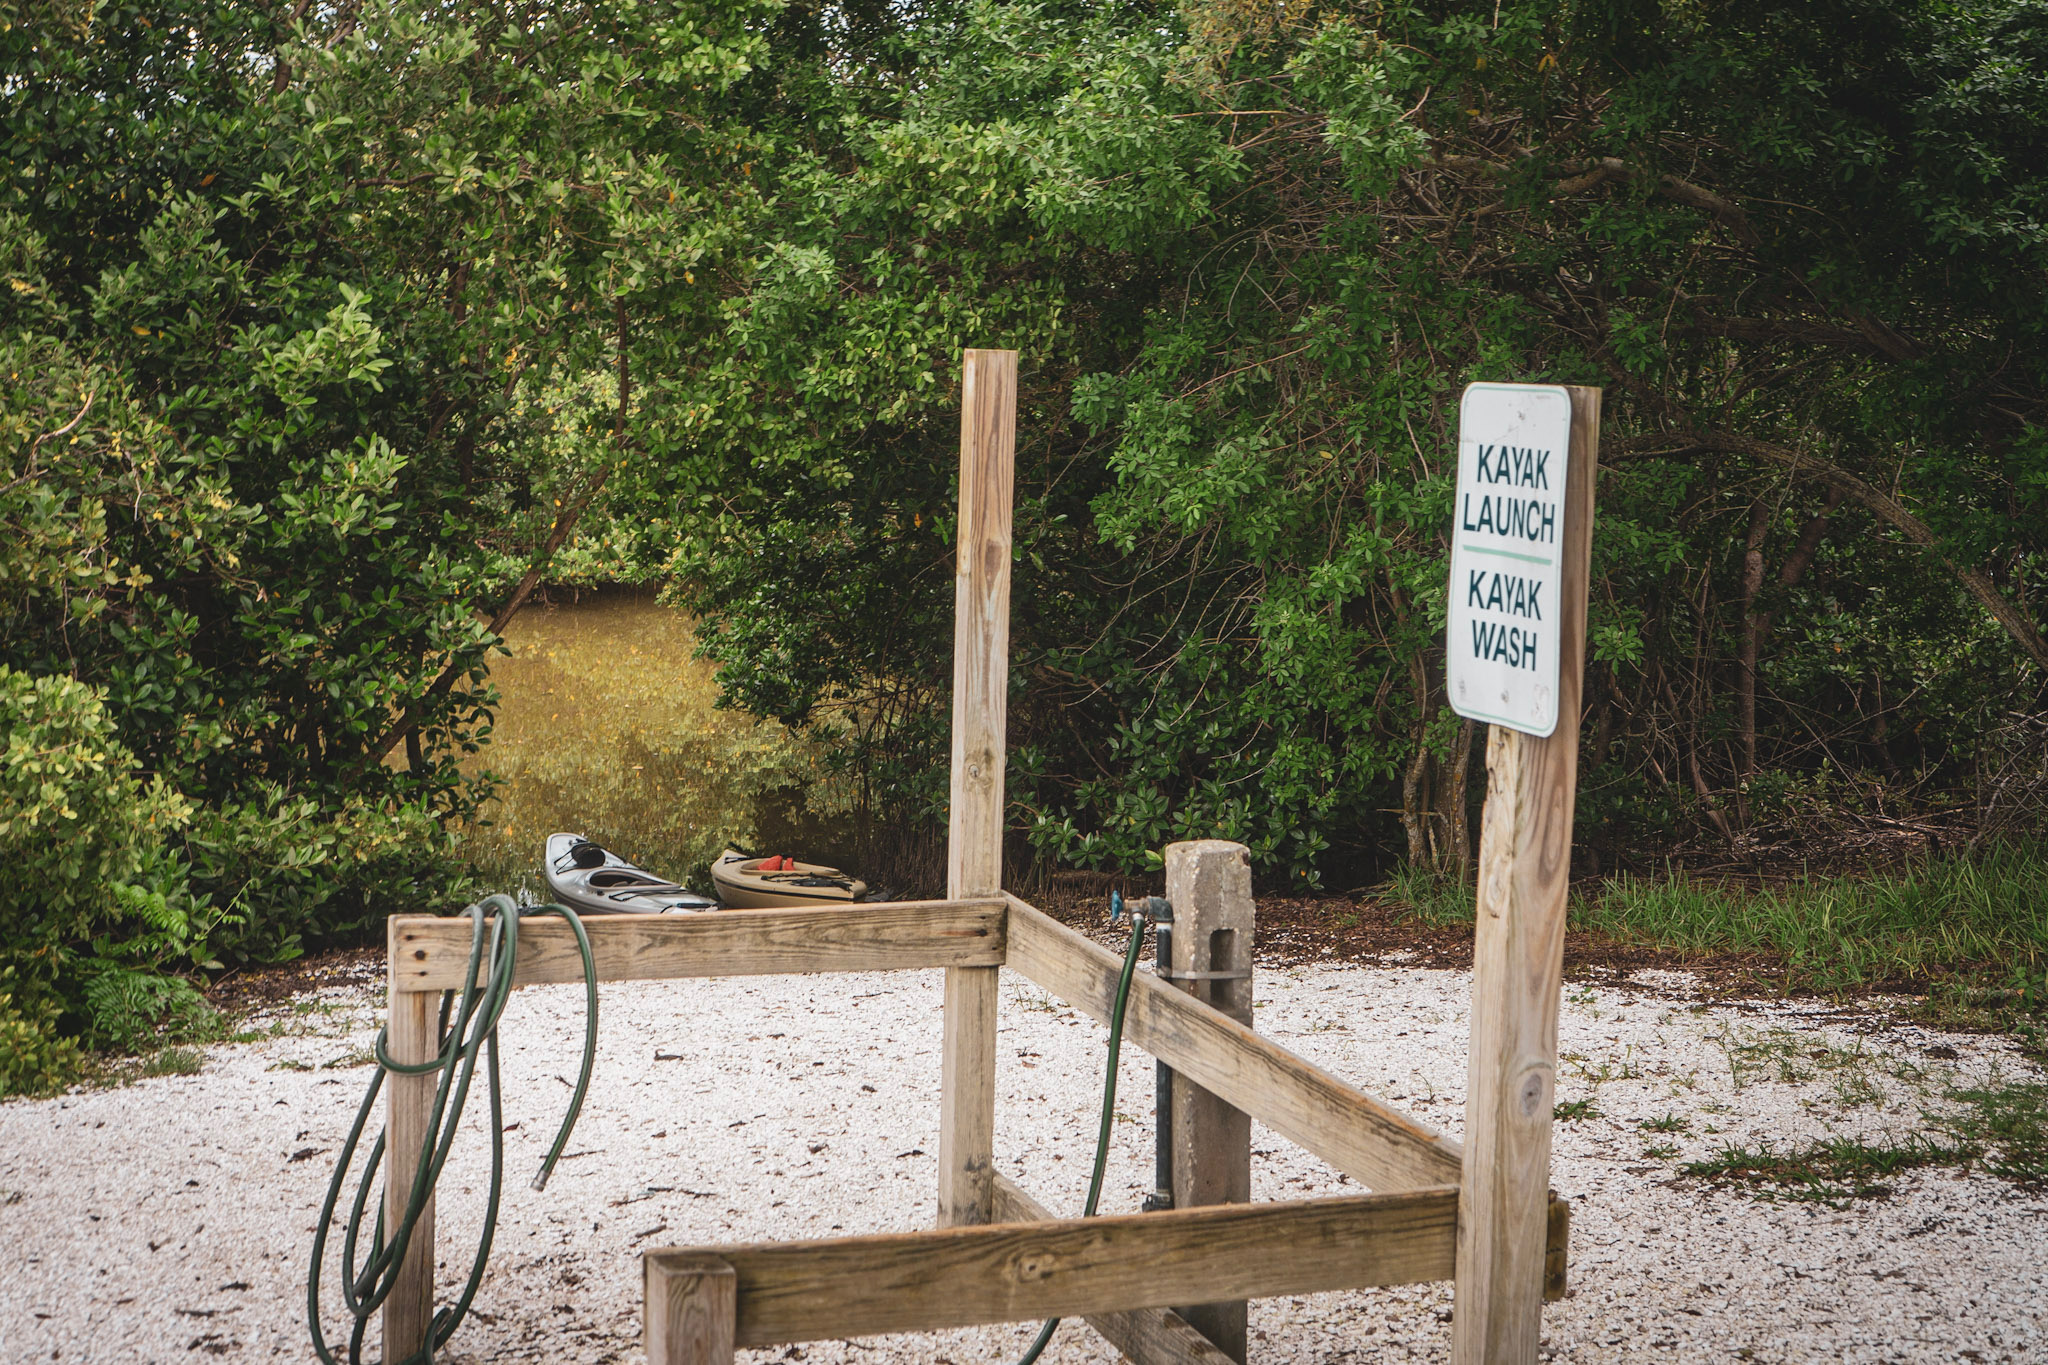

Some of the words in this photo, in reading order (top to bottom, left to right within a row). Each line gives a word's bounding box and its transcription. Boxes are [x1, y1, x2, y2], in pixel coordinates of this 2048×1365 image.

[1477, 444, 1551, 490] KAYAK
[1463, 493, 1556, 544] LAUNCH
[1468, 569, 1543, 621] KAYAK
[1471, 619, 1538, 672] WASH
